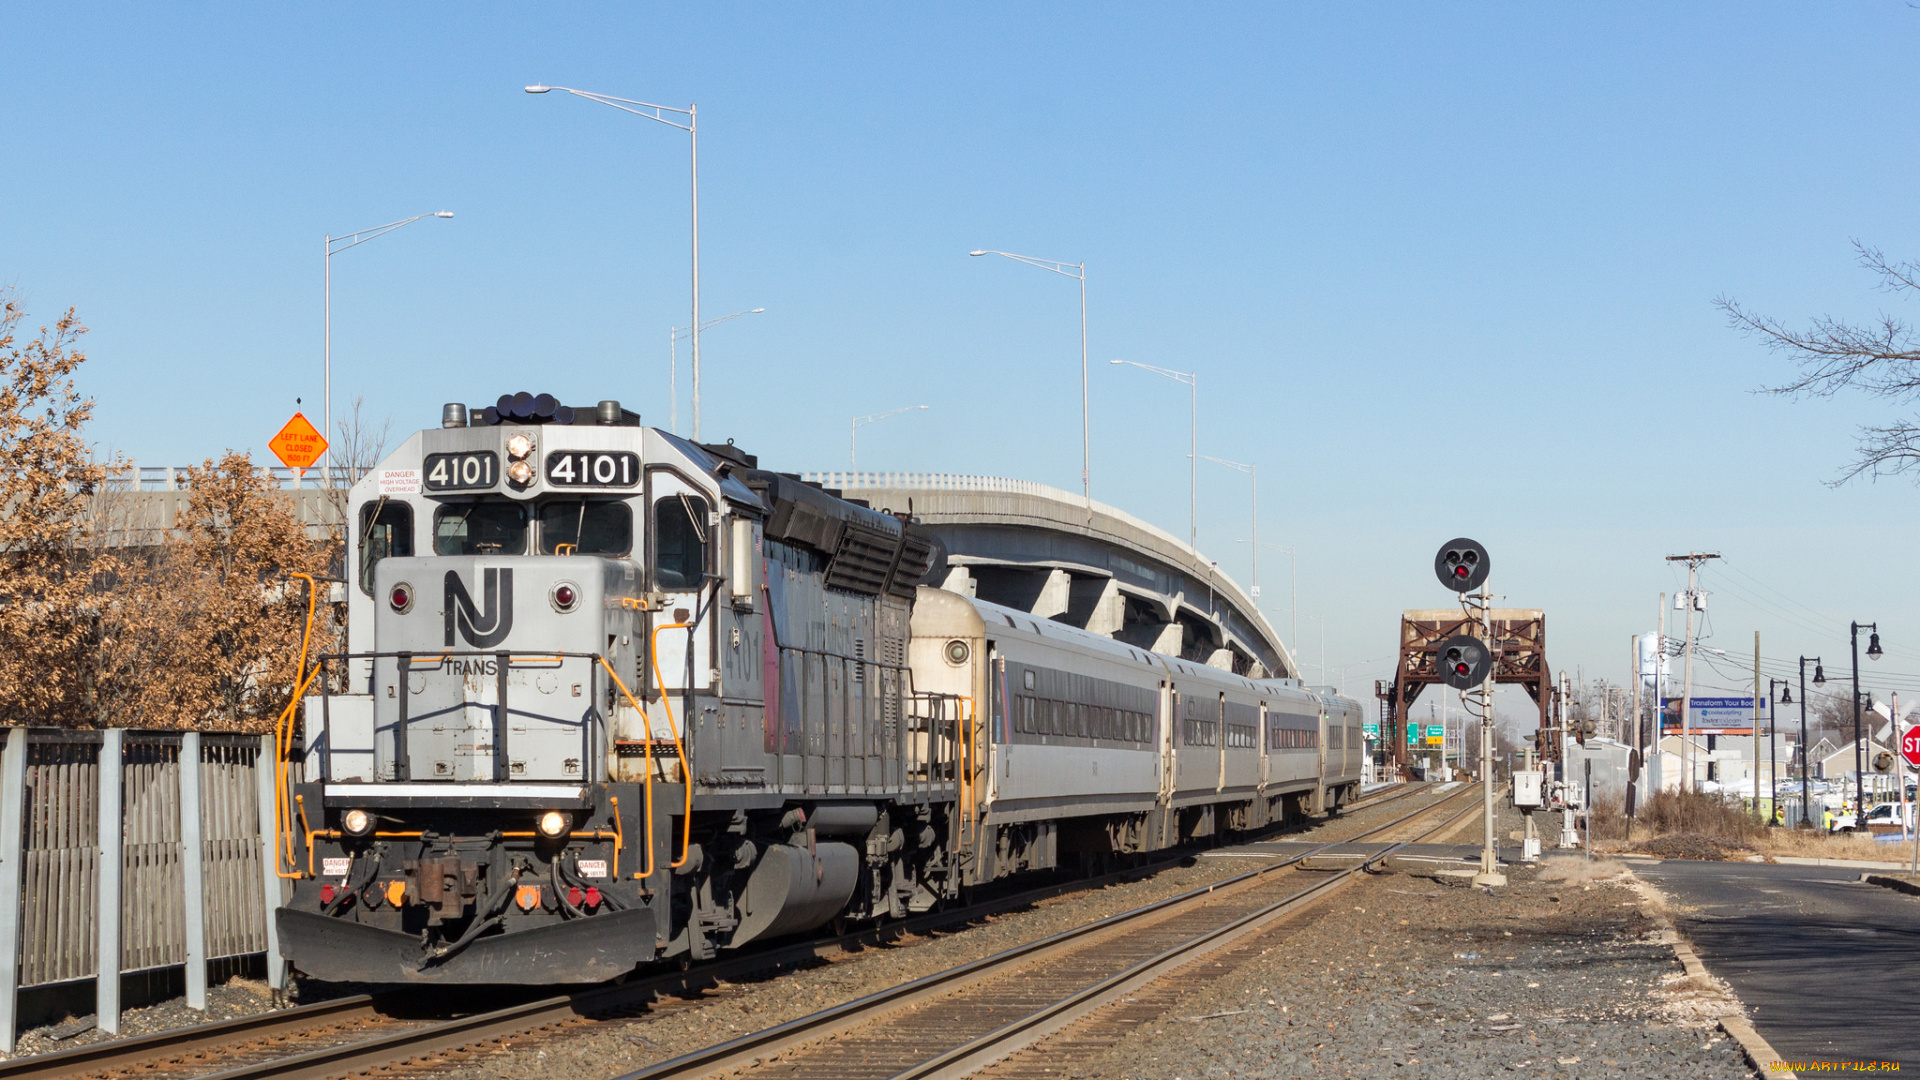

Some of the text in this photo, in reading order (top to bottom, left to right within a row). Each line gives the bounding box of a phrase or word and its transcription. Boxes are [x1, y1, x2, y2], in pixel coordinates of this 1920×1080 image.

[281, 433, 318, 443] LEFT LANE
[285, 443, 313, 453] CLOSED
[428, 456, 491, 486] 4101
[551, 455, 630, 484] 4101
[444, 567, 513, 649] NJ
[444, 660, 513, 676] TRANS
[1904, 737, 1920, 753] ST
[324, 859, 350, 867] DANGER
[580, 861, 606, 869] DANGER
